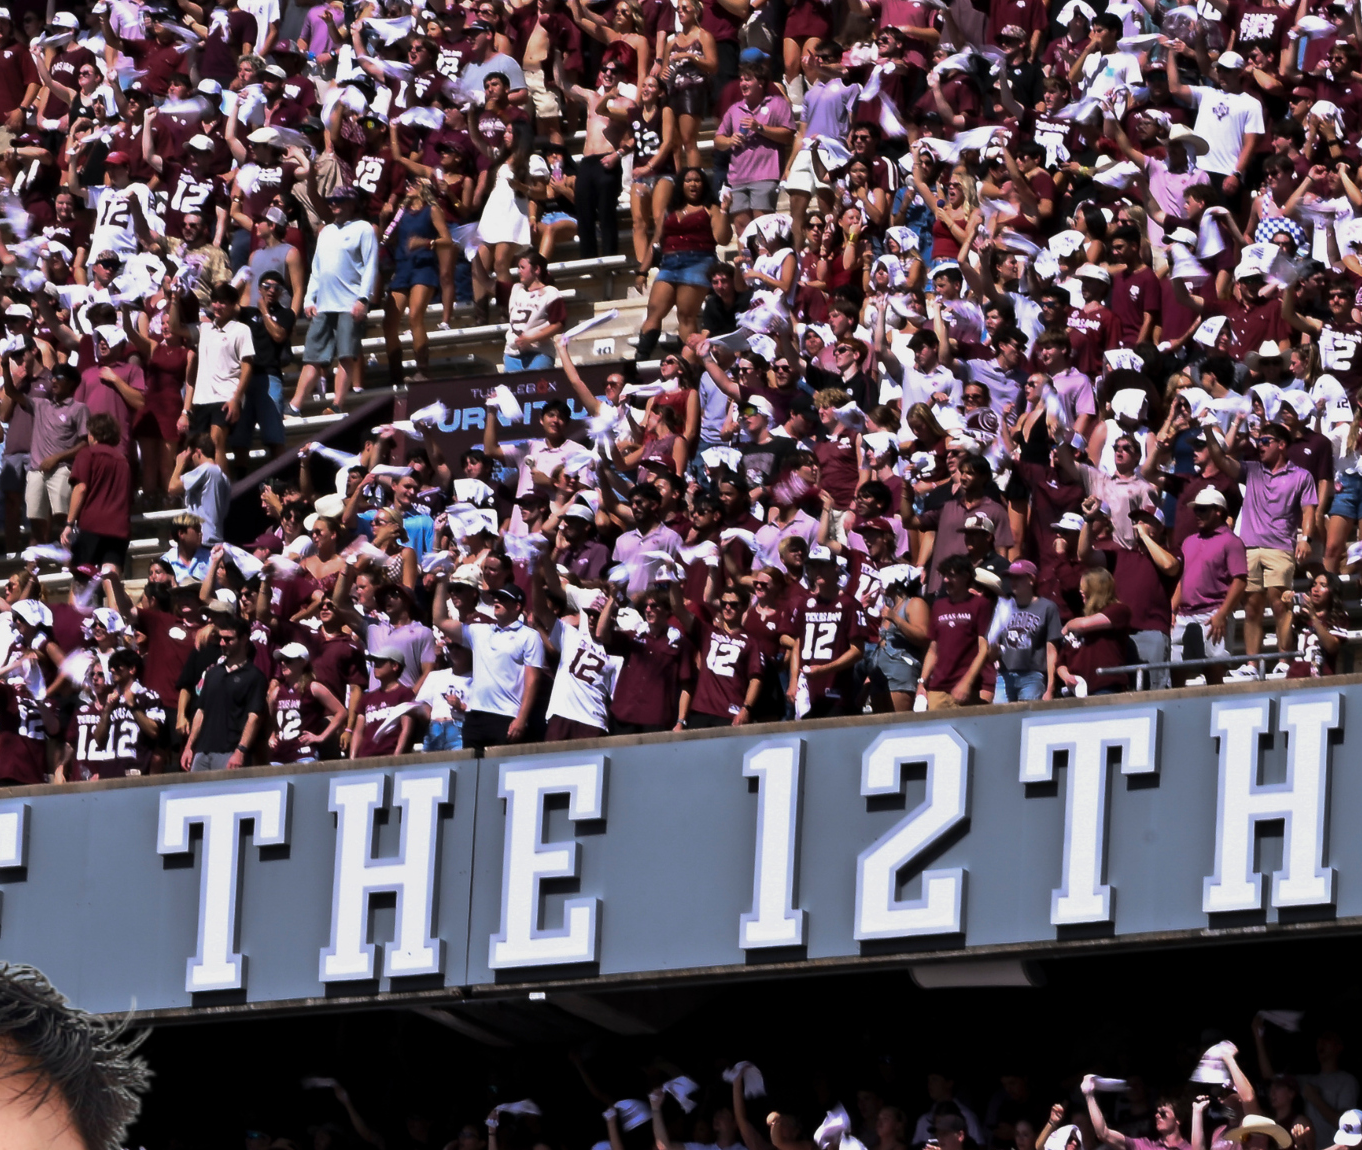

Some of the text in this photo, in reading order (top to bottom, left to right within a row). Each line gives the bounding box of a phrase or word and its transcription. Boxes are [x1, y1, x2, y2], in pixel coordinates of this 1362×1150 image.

[170, 178, 208, 212] 12
[104, 199, 131, 229] 12
[803, 623, 836, 660] 12
[569, 649, 605, 684] 12
[706, 643, 742, 682] 12
[278, 711, 301, 741] 12
[739, 690, 1343, 951] 12TH
[156, 754, 610, 993] THE
